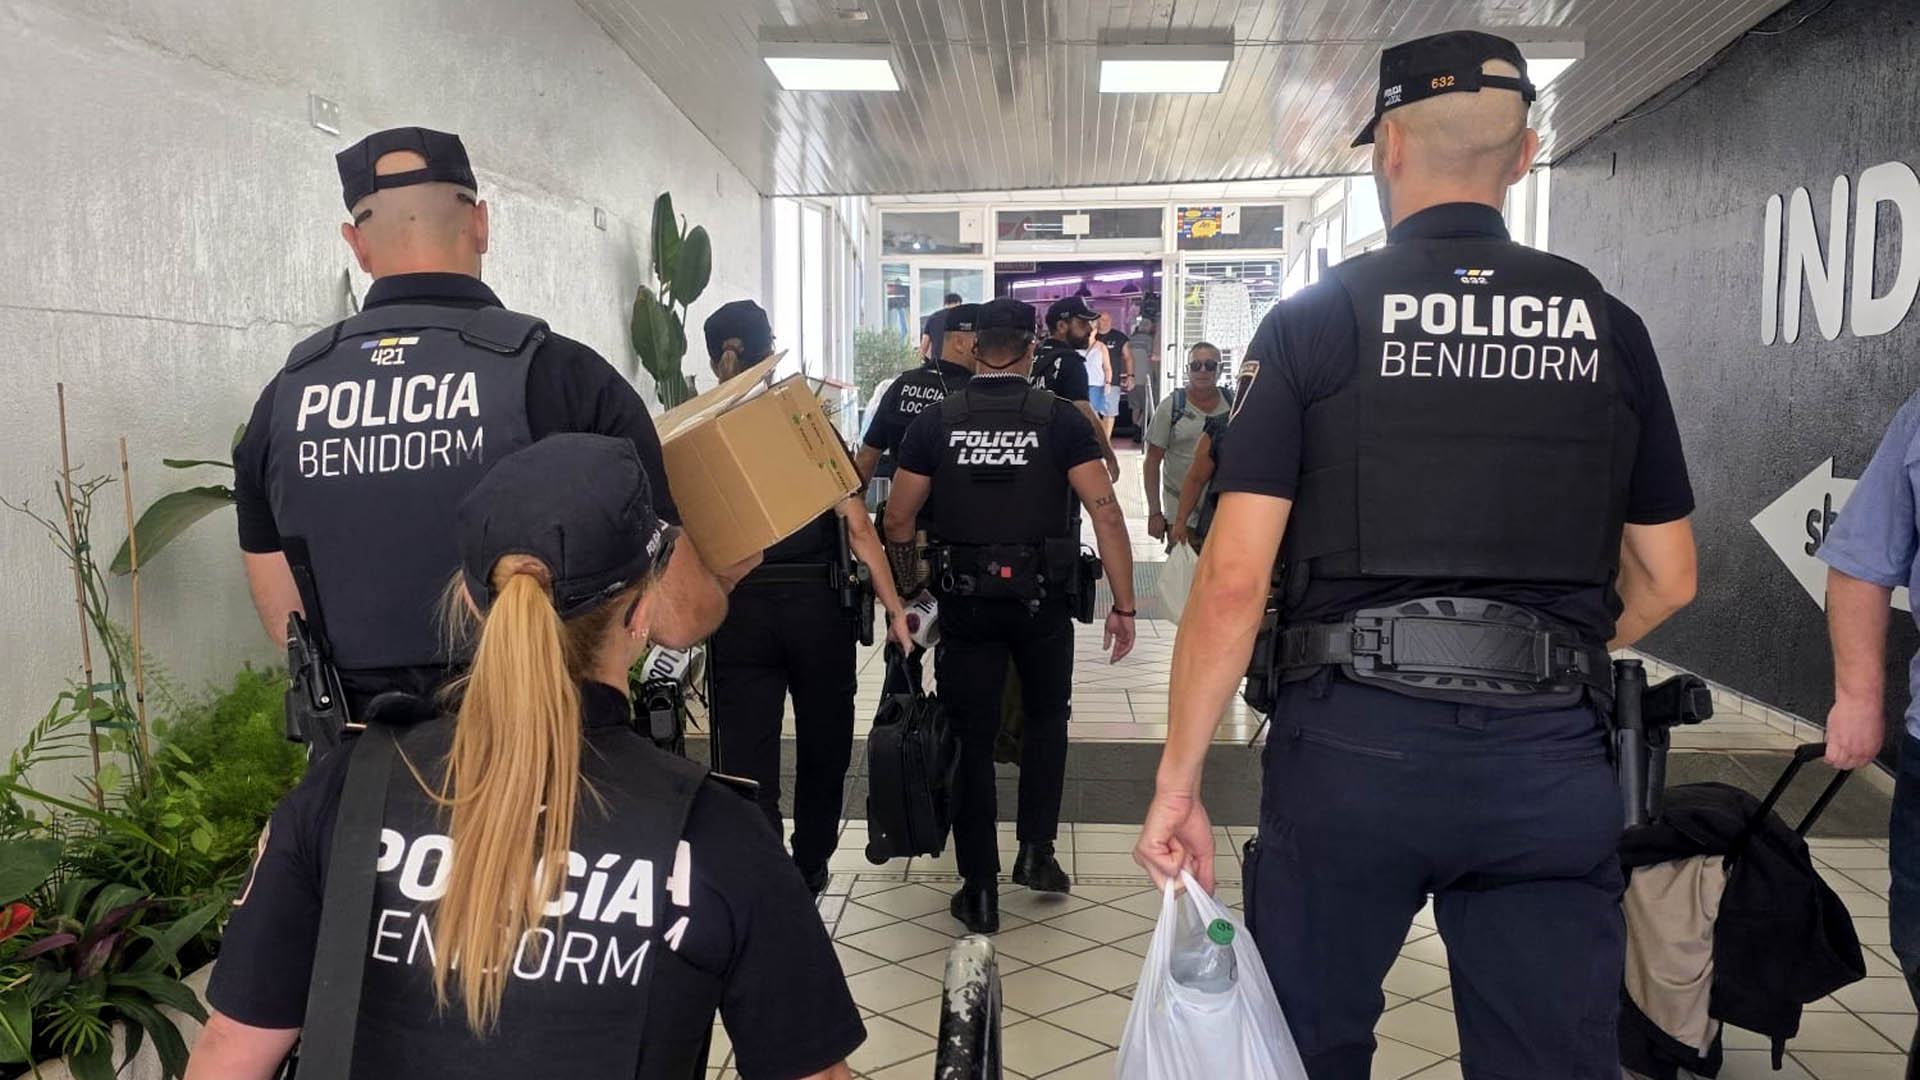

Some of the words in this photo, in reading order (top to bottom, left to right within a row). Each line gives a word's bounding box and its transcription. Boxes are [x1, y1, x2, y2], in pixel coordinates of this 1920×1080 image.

[1431, 75, 1455, 89] 632
[371, 347, 405, 366] 421
[1380, 341, 1599, 383] BENIDORM
[900, 400, 923, 414] LOC
[949, 430, 1039, 448] POLICIA
[299, 426, 483, 478] BENIDORM
[957, 448, 1029, 465] LOCAL
[372, 909, 651, 987] ENORM
